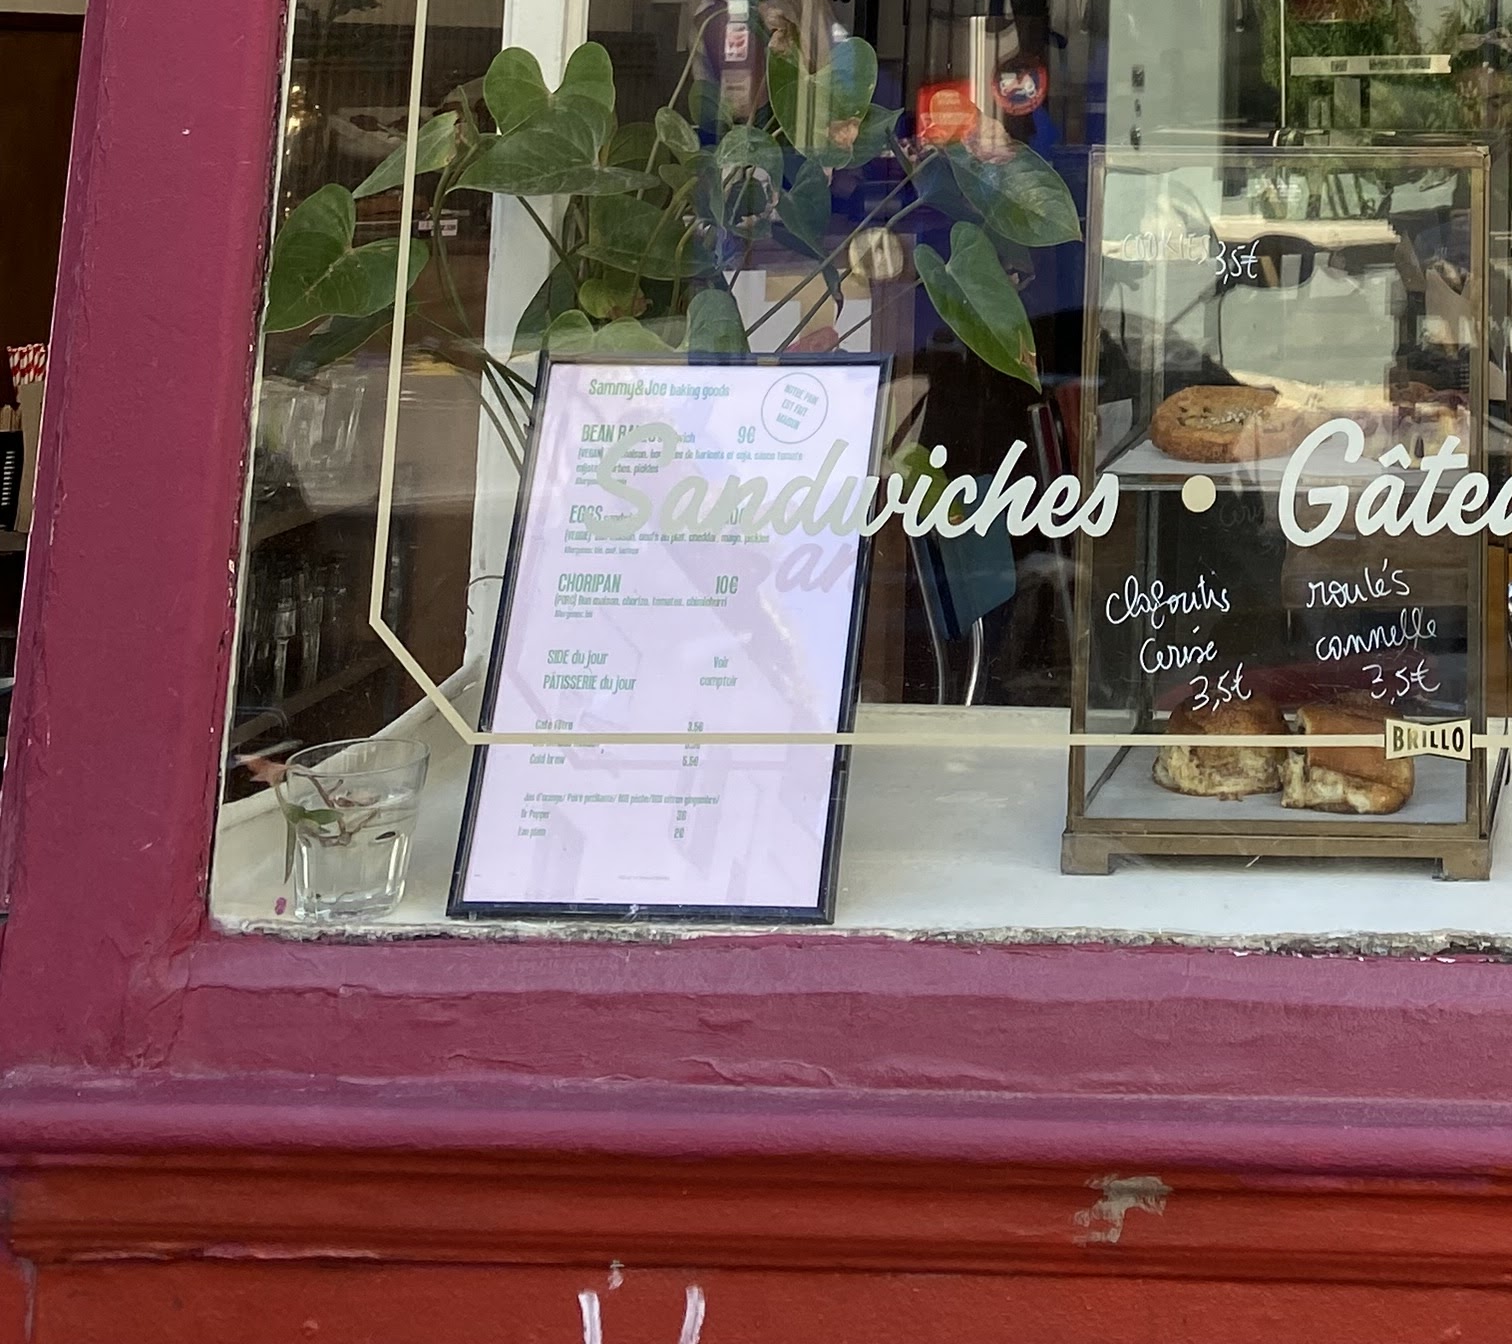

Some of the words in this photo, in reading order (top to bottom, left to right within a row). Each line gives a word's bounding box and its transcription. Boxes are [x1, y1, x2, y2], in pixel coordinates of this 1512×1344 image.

[1122, 230, 1211, 264] COOKIES
[1215, 240, 1260, 284] 3,5€
[669, 384, 700, 400] baking
[702, 384, 730, 400] goods
[581, 424, 615, 443] BEAN
[585, 421, 1120, 539] Sandwiches
[558, 573, 622, 593] CHORIPAN
[715, 575, 738, 594] 10€
[1307, 558, 1411, 608] roulés
[547, 649, 570, 665] SIDE
[1190, 662, 1253, 712] 3,5€
[1393, 725, 1465, 753] BRILLO
